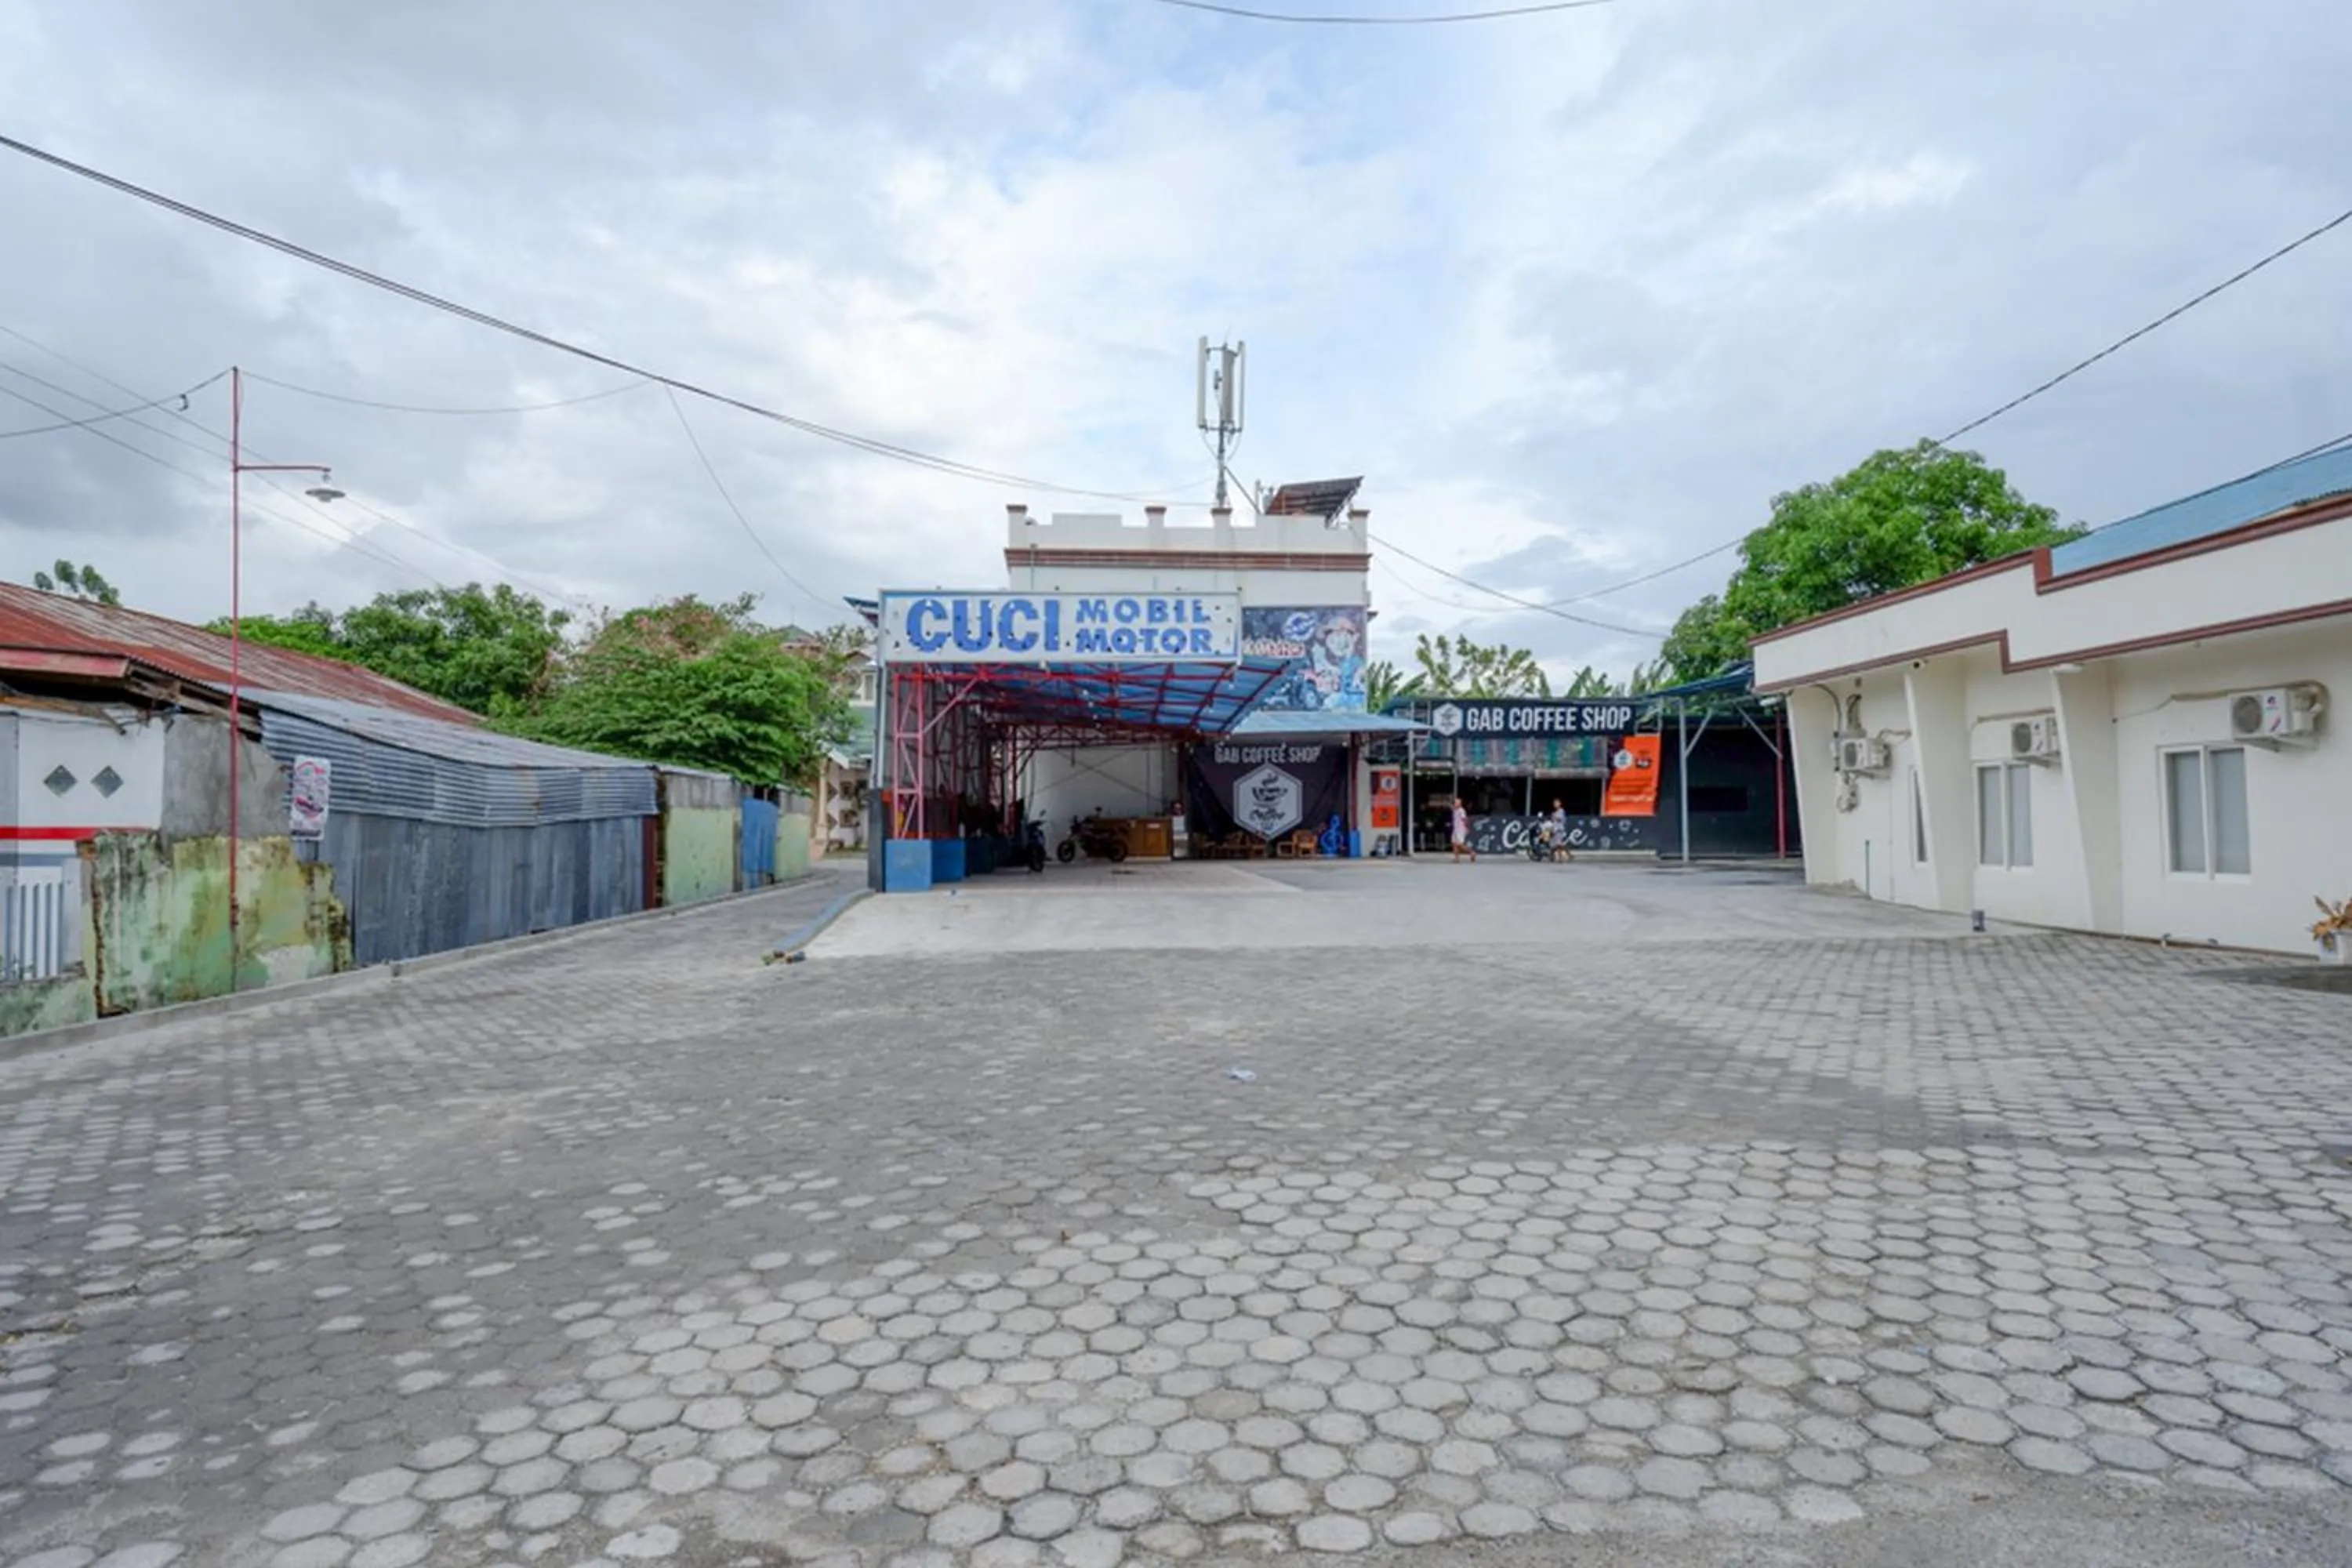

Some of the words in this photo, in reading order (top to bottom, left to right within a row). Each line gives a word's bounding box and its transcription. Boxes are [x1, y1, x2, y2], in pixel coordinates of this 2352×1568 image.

[1076, 598, 1210, 623] MOBIL
[906, 598, 1060, 652] CUCI
[1076, 628, 1212, 653] MOTOR
[1466, 707, 1504, 731] GAB
[1508, 707, 1577, 731] COFFEE
[1581, 706, 1632, 730] SHOP
[1242, 743, 1286, 764] COFFEE
[1288, 745, 1322, 763] SHOP
